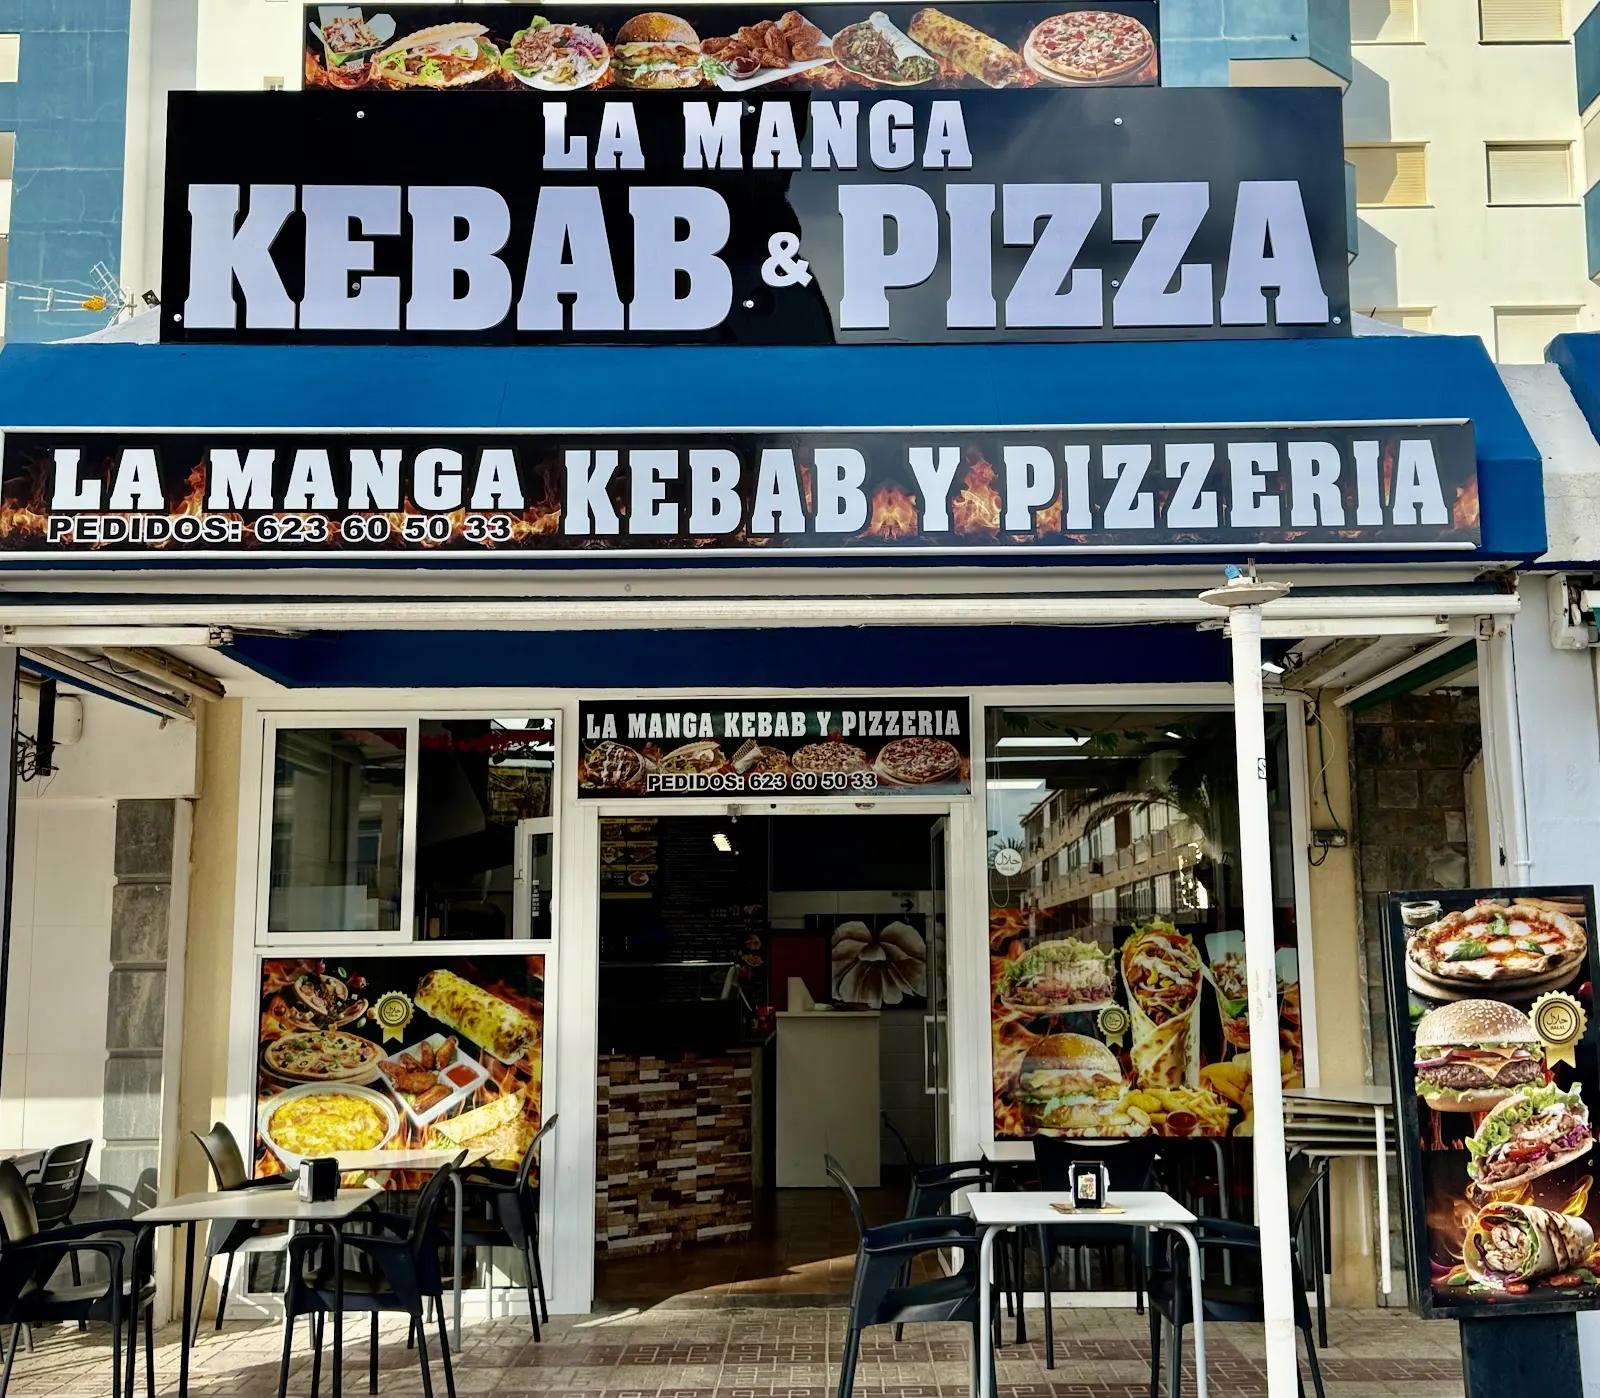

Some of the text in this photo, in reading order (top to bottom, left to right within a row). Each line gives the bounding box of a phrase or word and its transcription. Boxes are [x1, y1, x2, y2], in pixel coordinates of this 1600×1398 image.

[542, 99, 973, 169] LA MANGA
[184, 181, 1329, 331] KEBAB & PIZZA
[51, 440, 1448, 535] LA MANGA KEBAB Y PIZZERIA
[47, 514, 513, 542] PEDIDOS: 623 60 50 33
[586, 710, 960, 739] LA MANGA KEBAB Y PIZZERIA
[647, 770, 878, 791] PEDIDOS: 623 60 50 33
